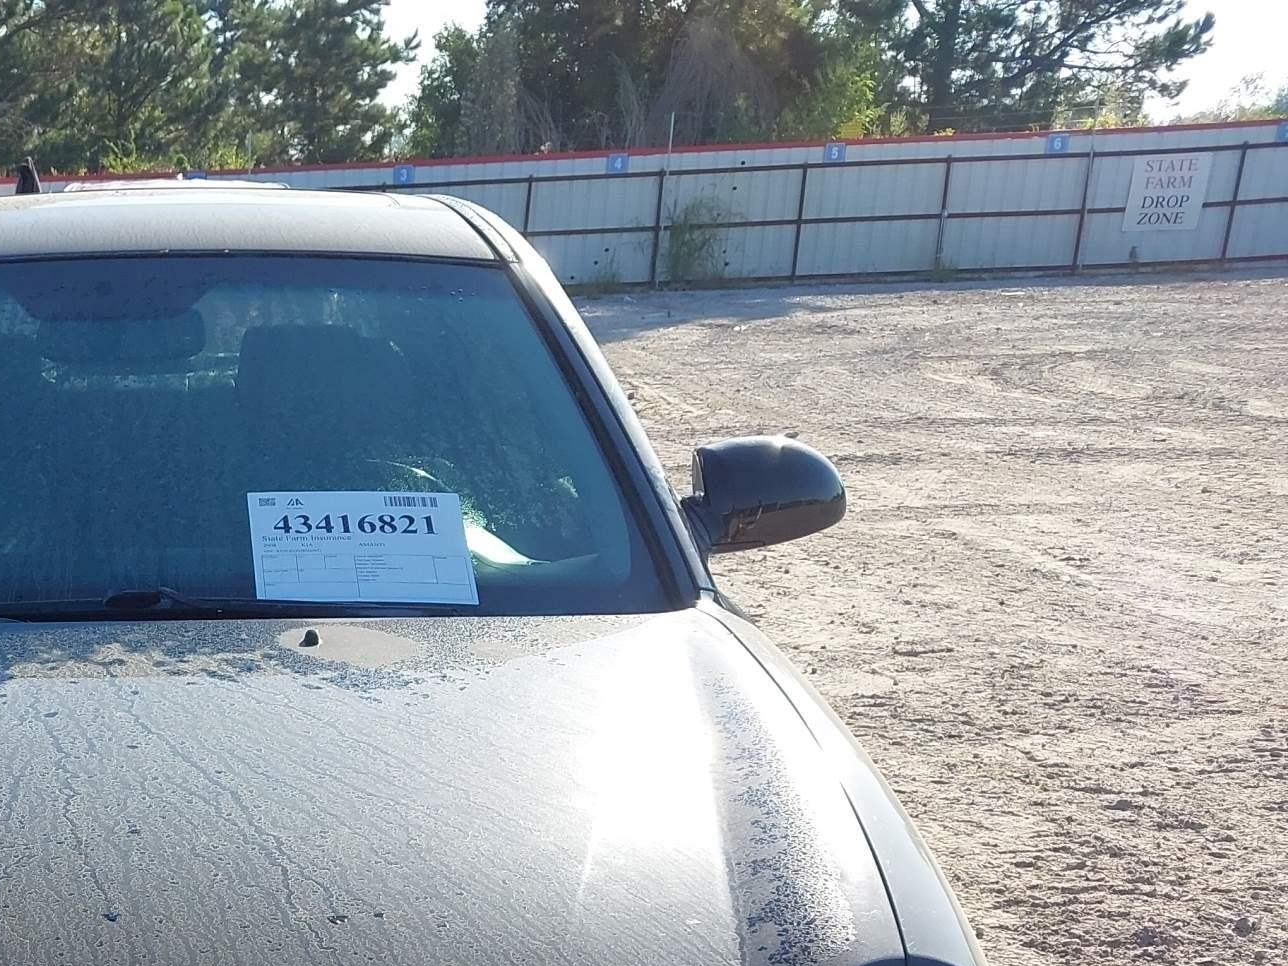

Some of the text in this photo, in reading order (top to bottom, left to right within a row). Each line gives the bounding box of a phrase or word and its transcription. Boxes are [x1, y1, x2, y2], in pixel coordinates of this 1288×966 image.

[1053, 137, 1062, 150] 6
[831, 146, 839, 159] 5
[614, 157, 623, 169] 4
[1144, 158, 1199, 173] STATE
[400, 169, 408, 181] 3
[1144, 175, 1193, 190] FARM
[1141, 194, 1190, 209] DROP
[1136, 211, 1185, 226] ZONE
[273, 512, 440, 535] 43416821
